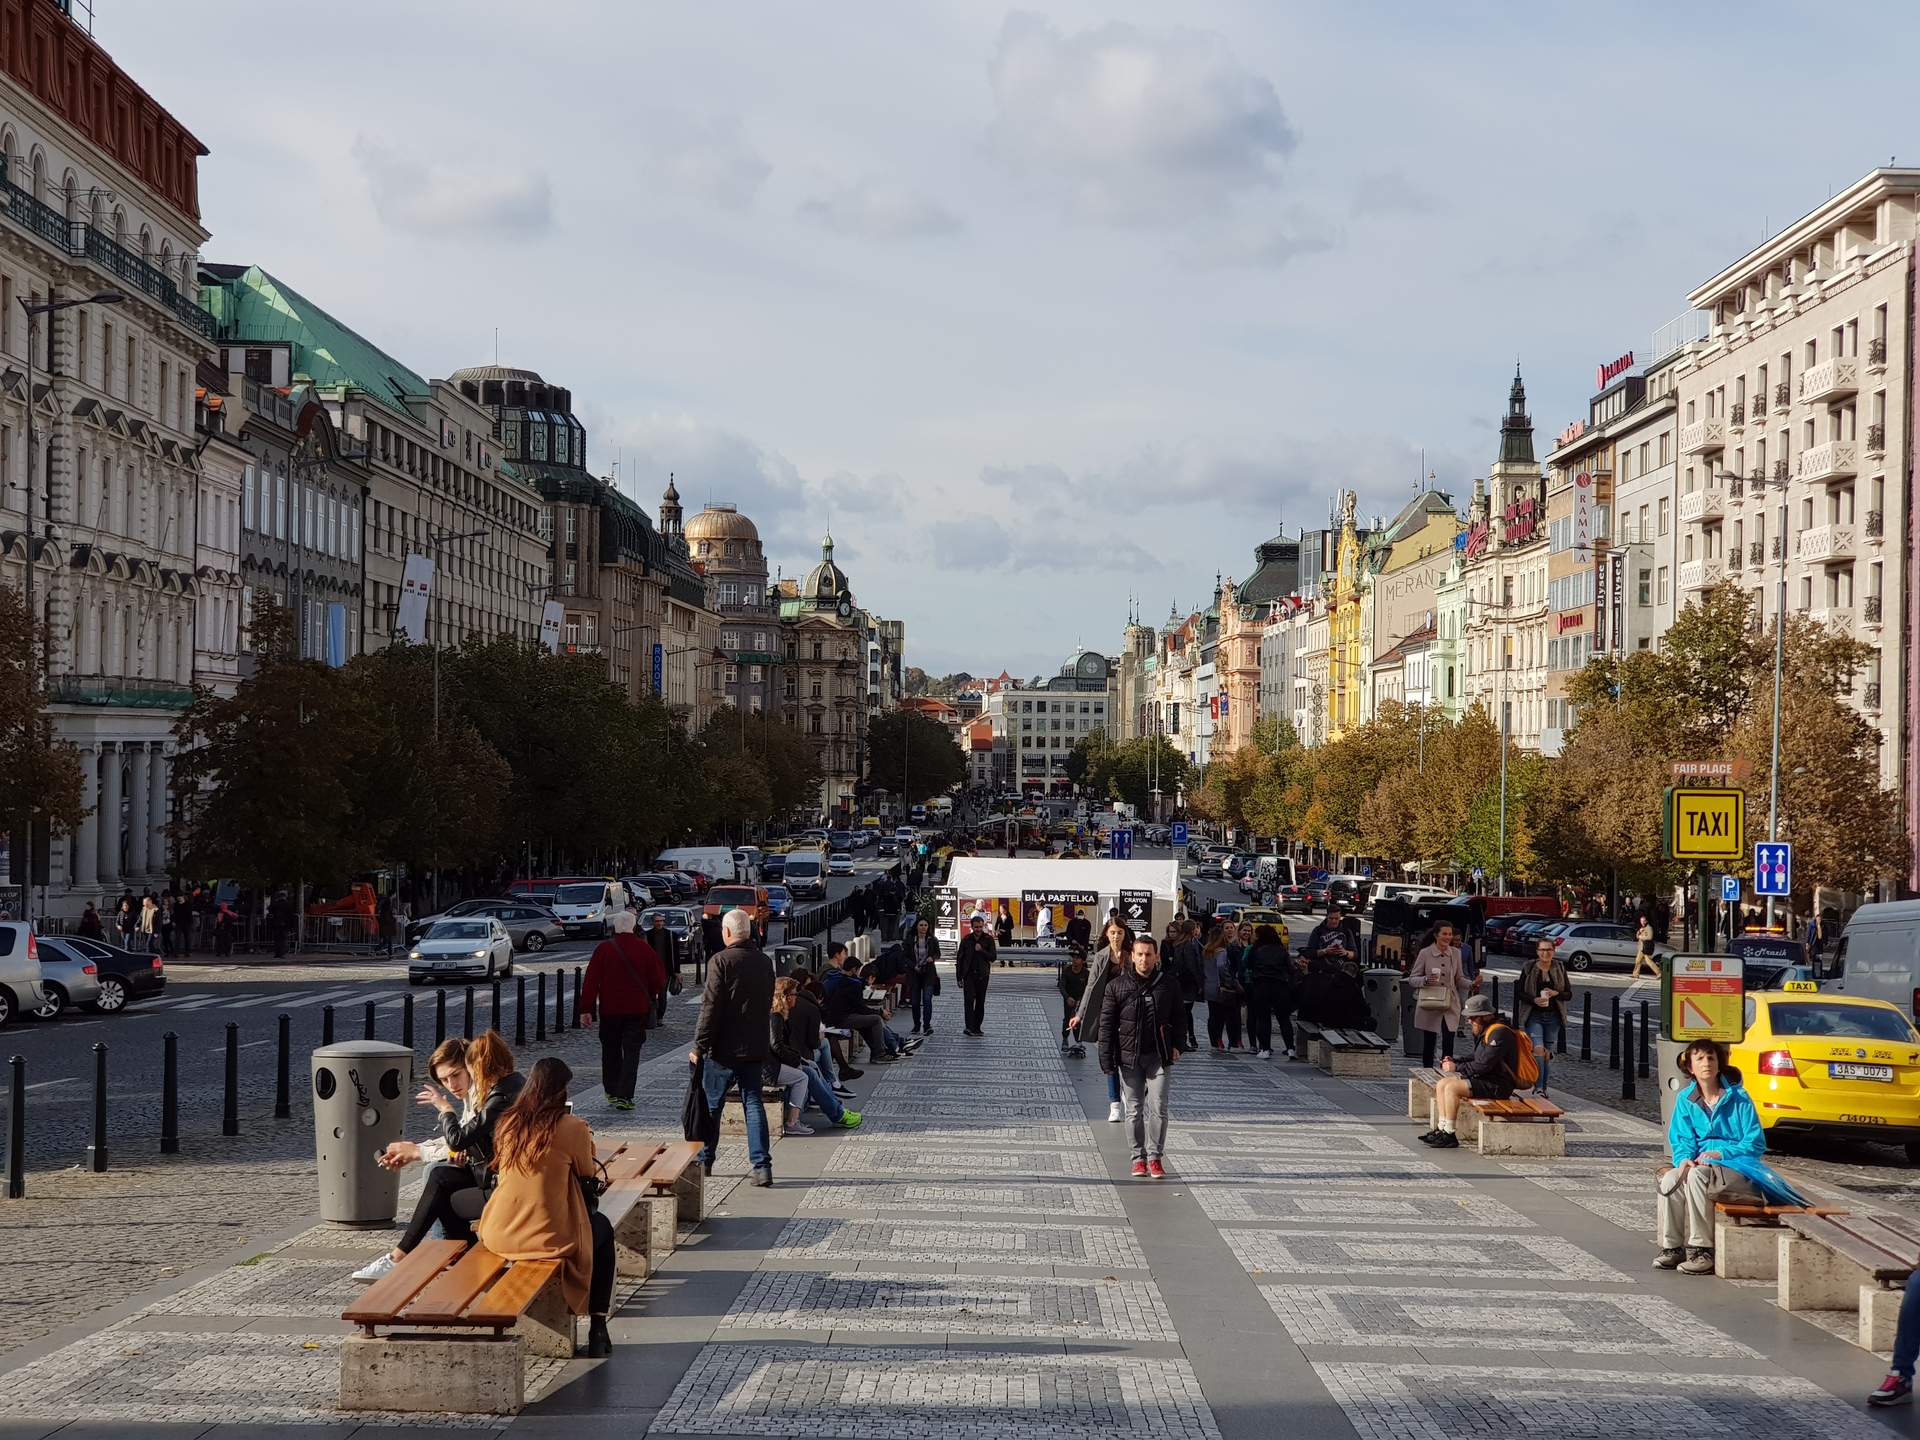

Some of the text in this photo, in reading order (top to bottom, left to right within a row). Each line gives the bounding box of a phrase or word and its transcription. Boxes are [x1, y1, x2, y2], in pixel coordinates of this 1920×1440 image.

[1714, 244, 1816, 327] HOTEL
[1386, 569, 1434, 601] MERAN
[1673, 763, 1732, 774] FAIR PLACE
[1686, 811, 1728, 836] TAXI
[1174, 824, 1184, 838] P
[1725, 879, 1735, 893] P
[1025, 893, 1095, 903] BÍLÁ PASTELKA
[1837, 1065, 1888, 1076] 3AS 0079
[1847, 1114, 1878, 1124] 14014
